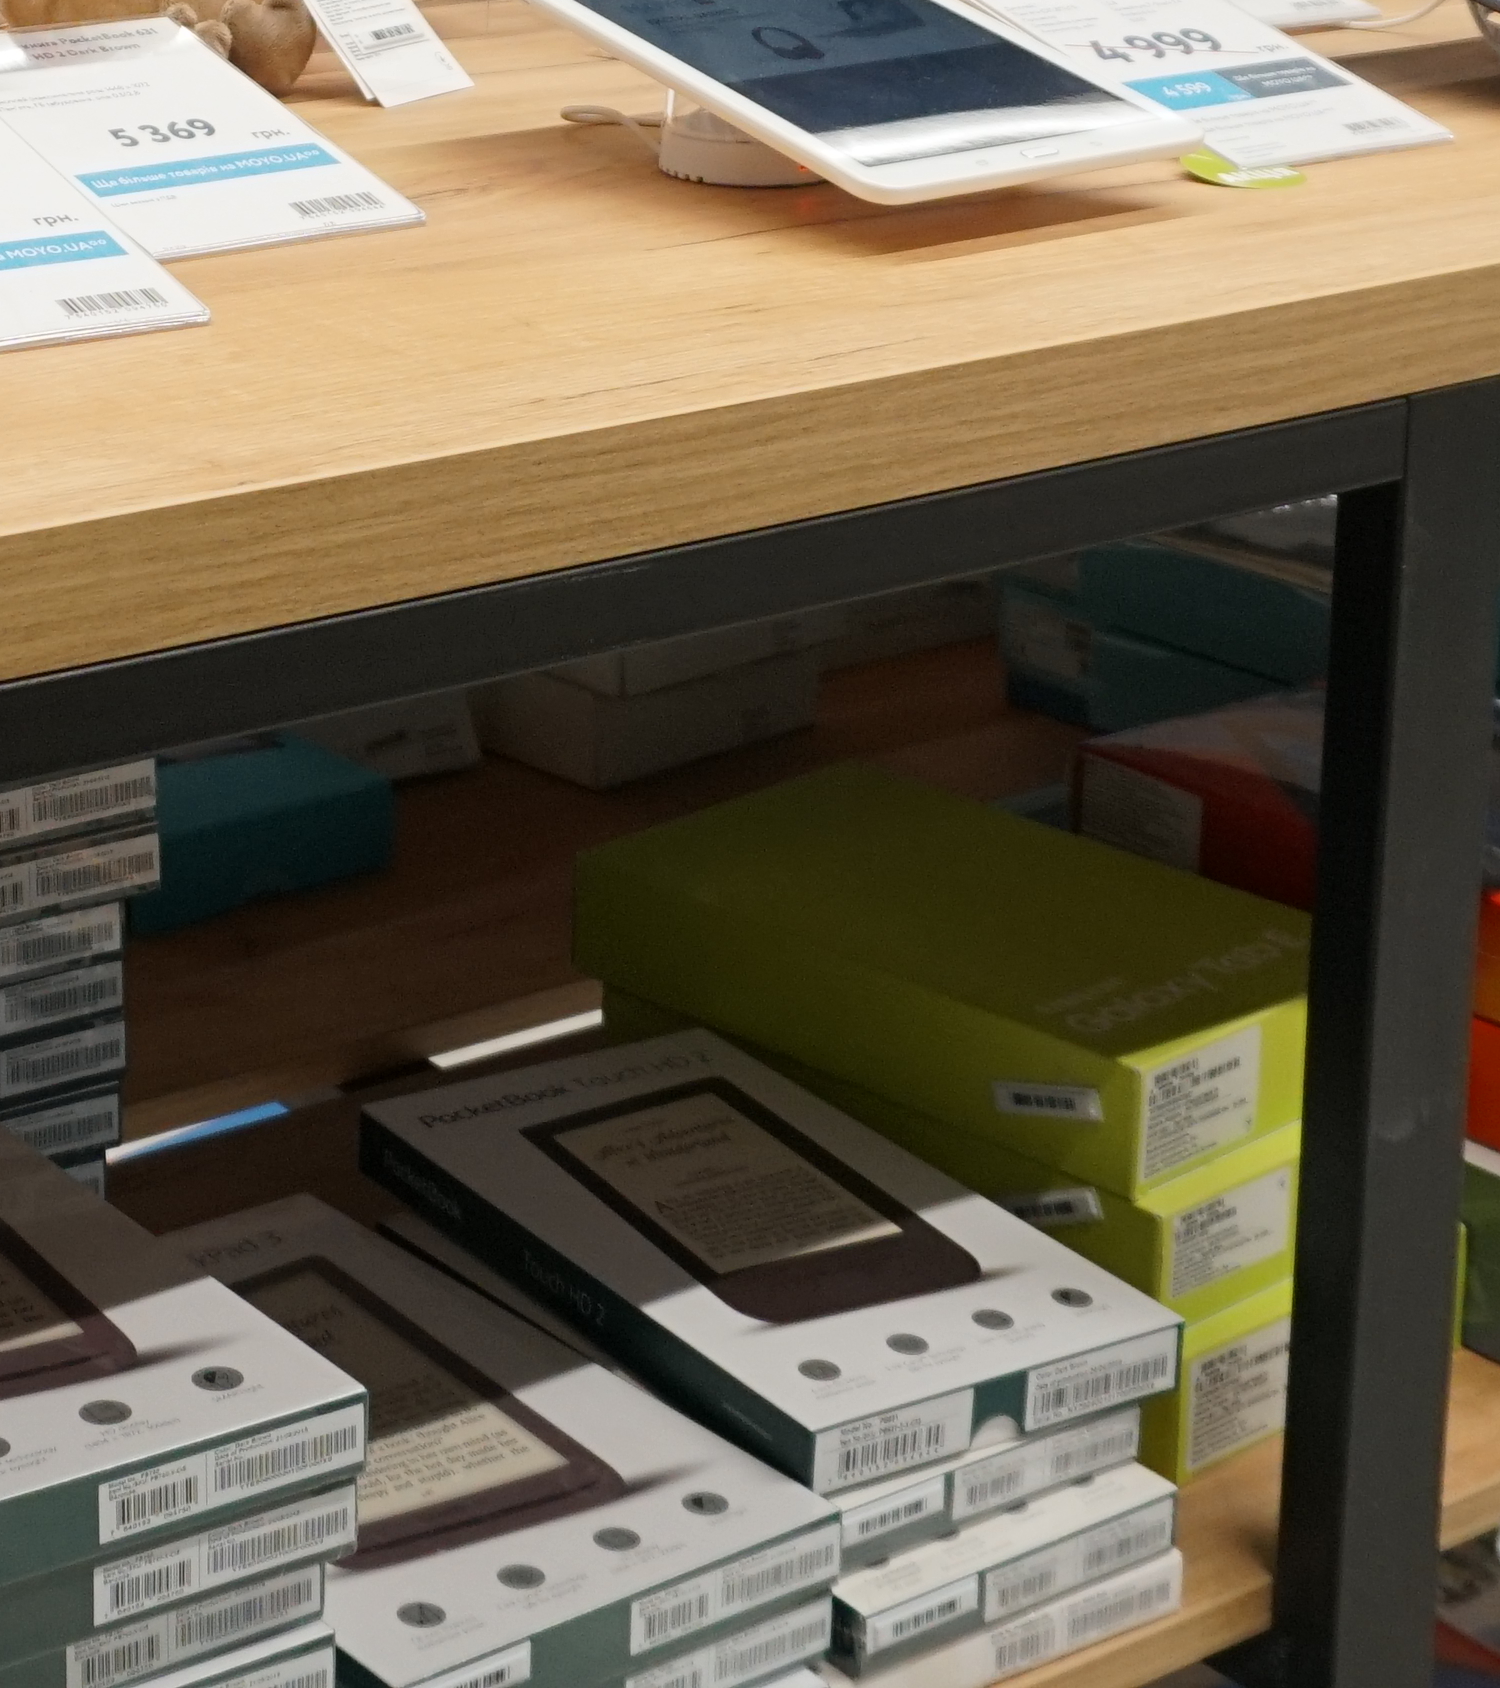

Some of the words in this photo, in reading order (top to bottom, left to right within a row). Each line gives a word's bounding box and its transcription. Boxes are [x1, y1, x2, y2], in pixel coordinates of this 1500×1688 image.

[57, 29, 137, 46] PocketBook
[1088, 40, 1135, 64] 4
[1127, 28, 1224, 60] 999
[31, 52, 56, 60] HD
[65, 47, 100, 56] Dark
[97, 41, 143, 52] Brown
[1162, 87, 1179, 99] 4
[1178, 81, 1212, 95] 599
[107, 124, 140, 149] 5
[151, 117, 217, 144] 369
[248, 127, 292, 139] грн.
[89, 178, 119, 189] Ще
[30, 213, 81, 227] грн.
[419, 1087, 569, 1129] PocketBook
